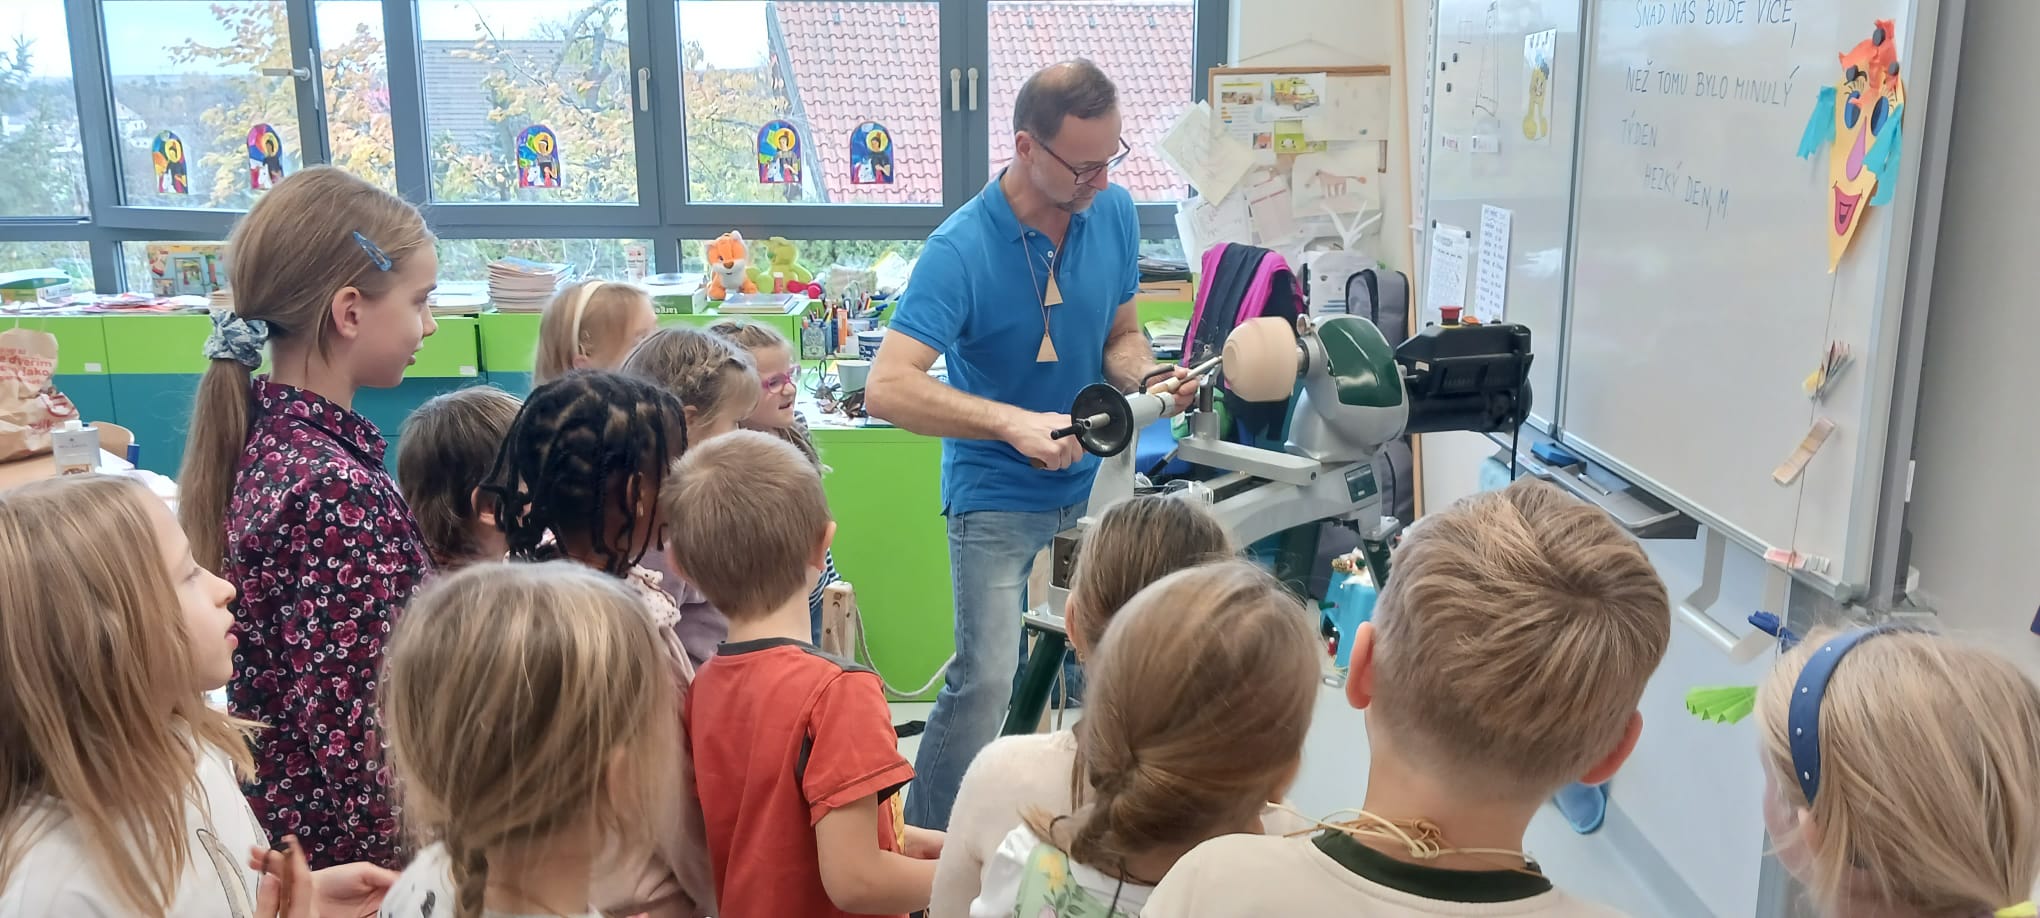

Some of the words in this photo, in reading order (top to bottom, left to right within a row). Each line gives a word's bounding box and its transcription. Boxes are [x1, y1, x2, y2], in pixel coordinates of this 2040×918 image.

[1634, 0, 1665, 28] SNAD
[1705, 0, 1745, 25] BUDE
[1625, 60, 1653, 93] NEŽ
[1658, 70, 1689, 96] TOMU
[1696, 71, 1729, 100] BYLO
[1734, 65, 1800, 107] MINULÝ
[1621, 109, 1658, 148] TÝDEN
[1644, 161, 1682, 196] HEZKÝ
